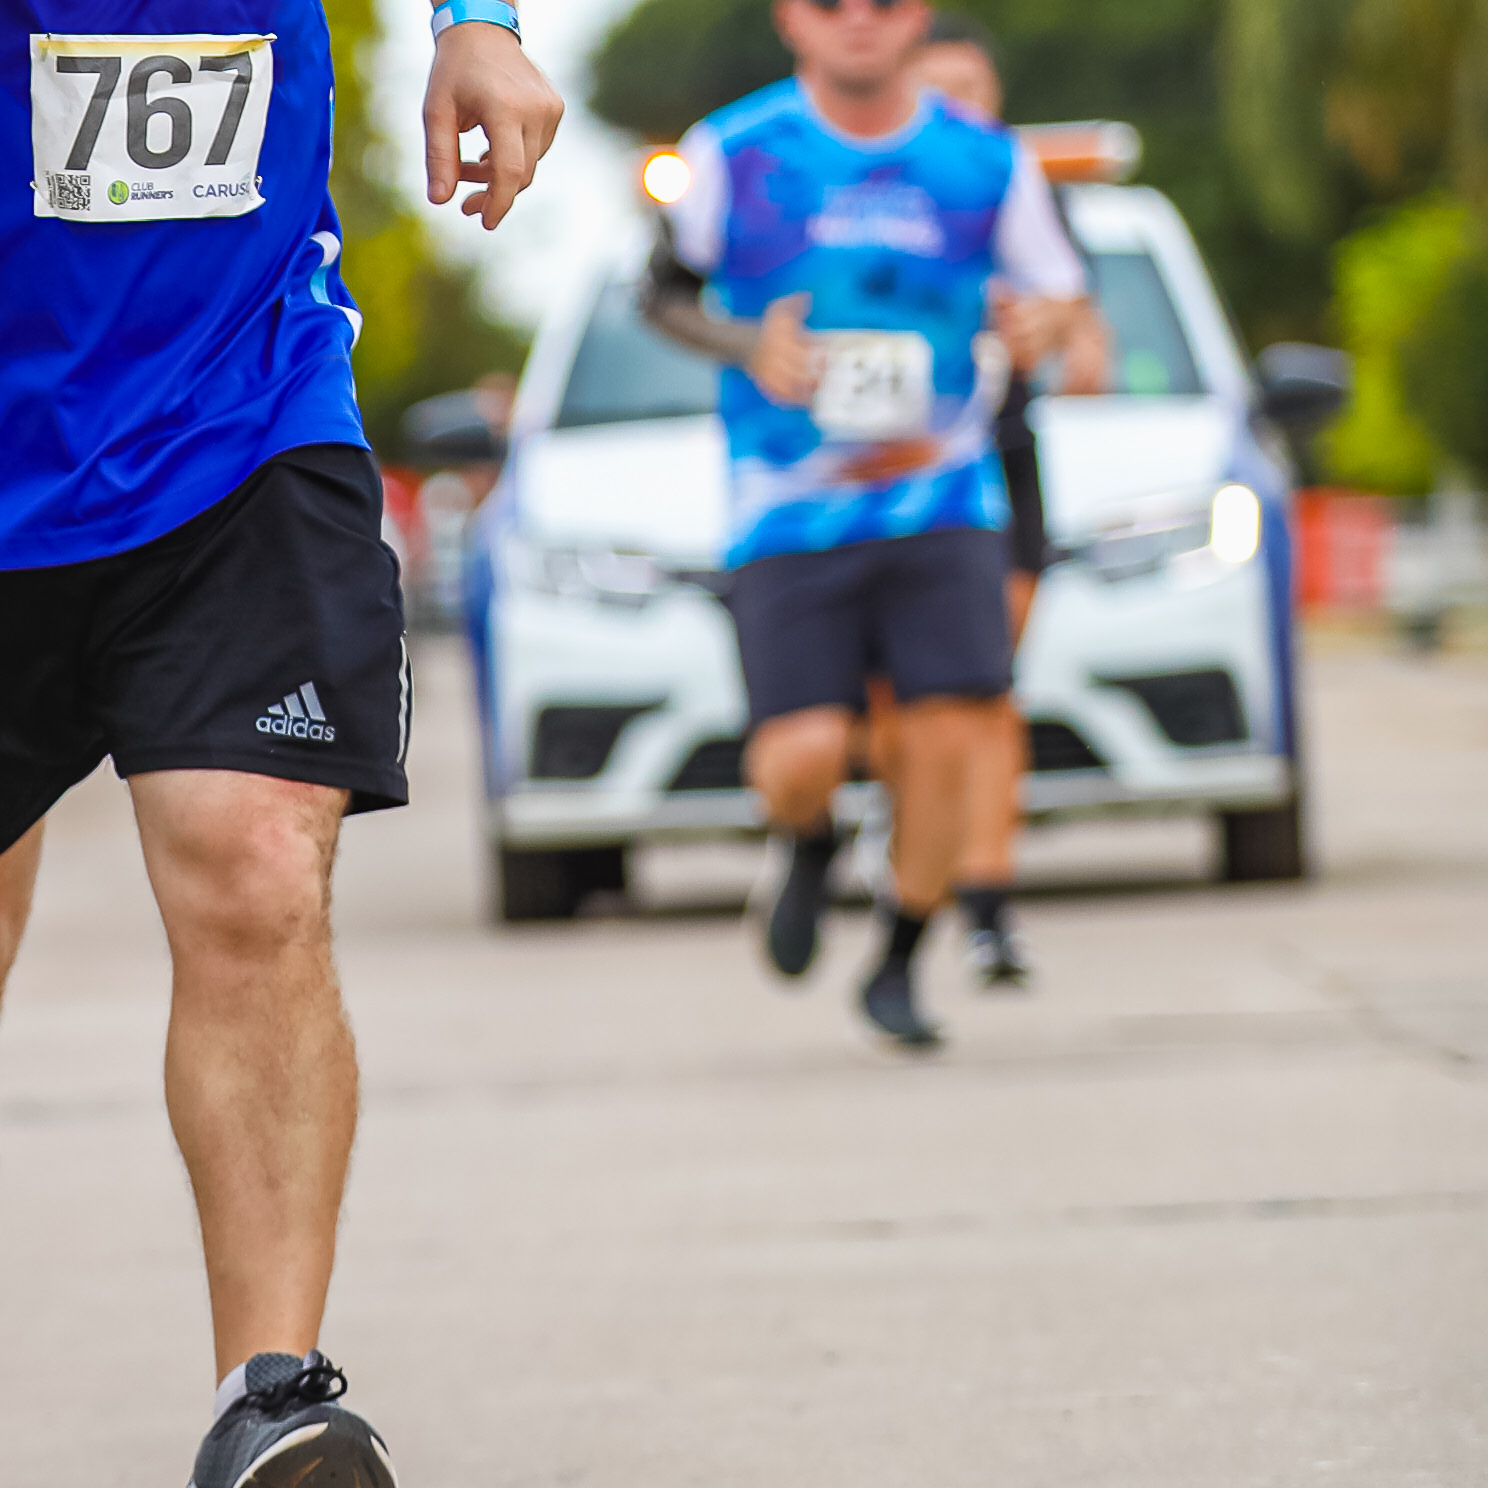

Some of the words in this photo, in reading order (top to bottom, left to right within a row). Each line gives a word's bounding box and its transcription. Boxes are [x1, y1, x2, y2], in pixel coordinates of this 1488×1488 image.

[56, 51, 253, 170] 767
[131, 182, 154, 191] CLUB
[255, 712, 336, 743] adidas
